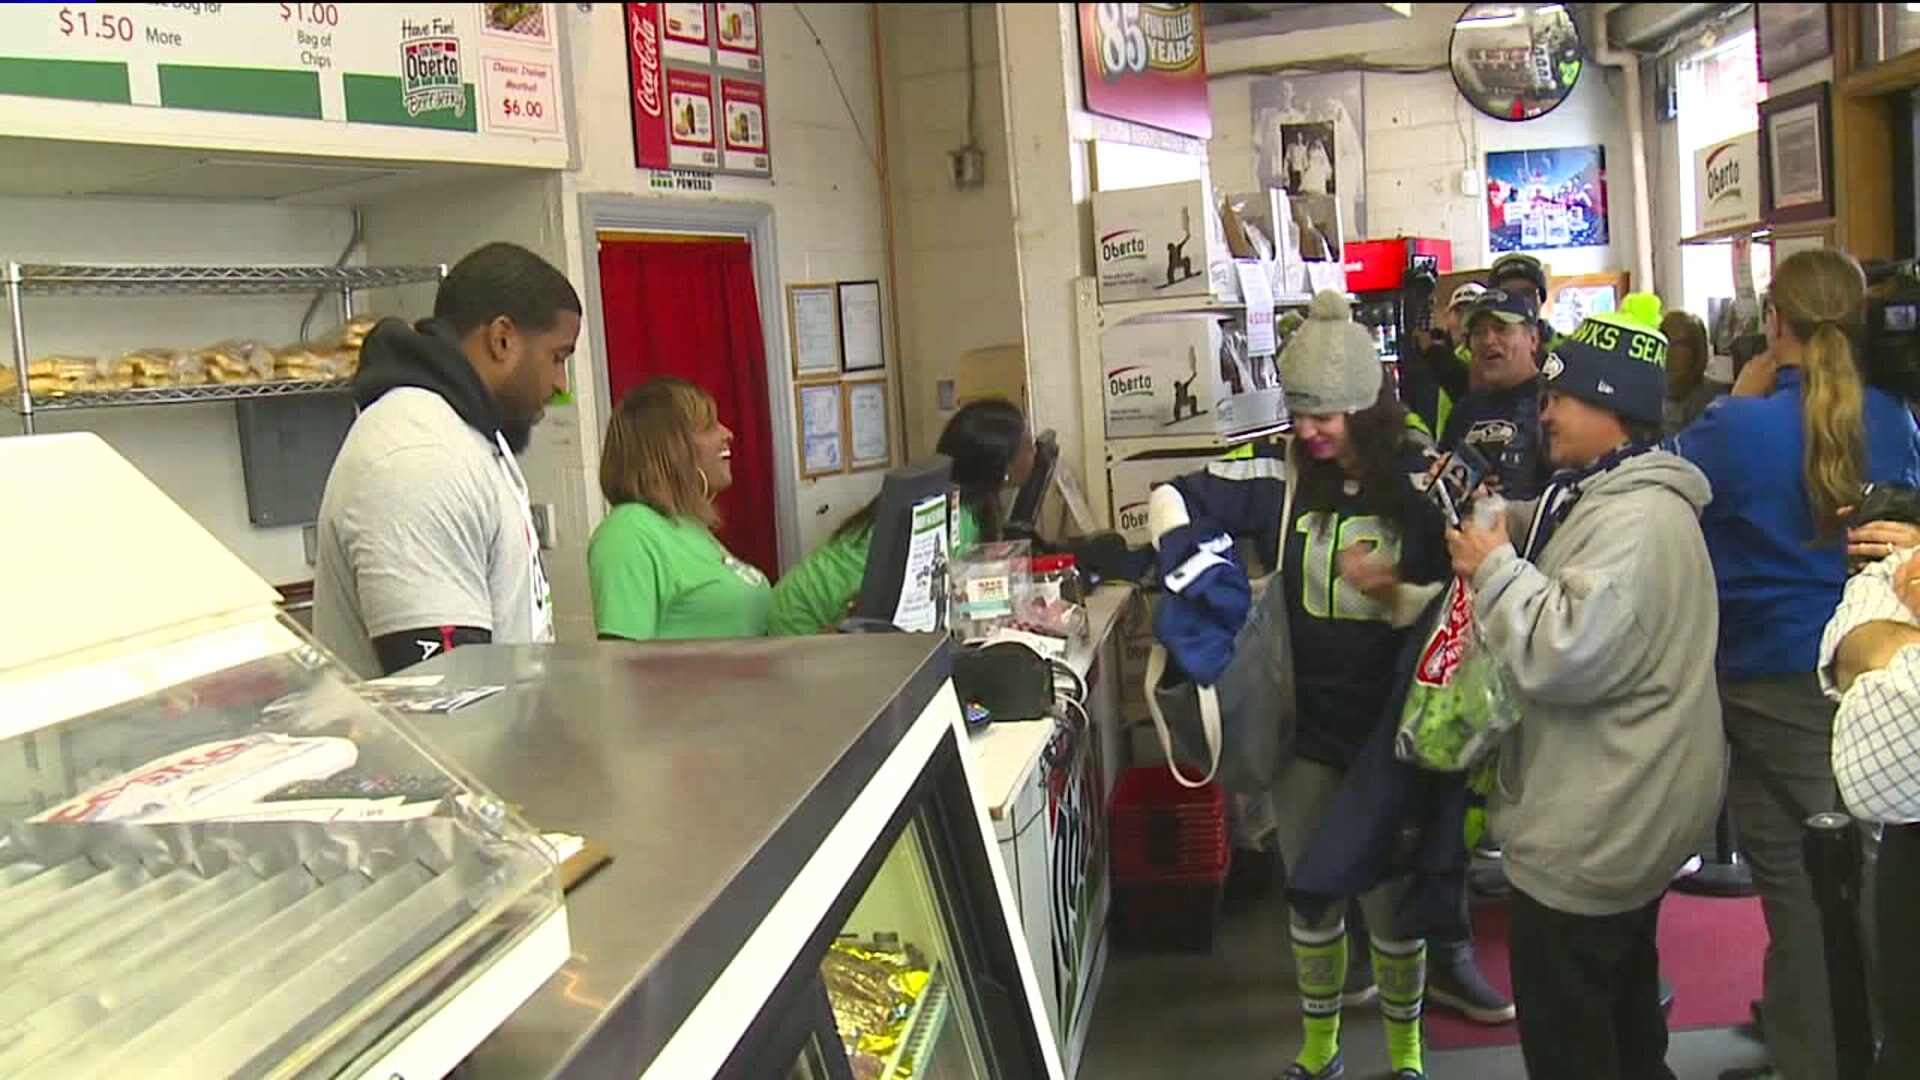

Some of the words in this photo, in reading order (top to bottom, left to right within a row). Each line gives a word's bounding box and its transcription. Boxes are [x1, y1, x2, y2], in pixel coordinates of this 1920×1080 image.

[59, 7, 134, 41] $1.50
[280, 3, 339, 26] $1.00
[145, 27, 182, 46] More
[297, 30, 319, 48] Bag
[321, 35, 332, 47] of
[402, 18, 429, 38] Have
[1098, 3, 1148, 73] 85
[301, 51, 332, 67] Chips
[1148, 35, 1194, 63] YEARS
[406, 54, 459, 81] Oberto
[632, 11, 661, 117] Coca-Cola
[503, 98, 543, 119] $6.00
[1707, 159, 1740, 200] Oberto
[1103, 237, 1145, 261] Oberto
[1110, 374, 1152, 396] Oberto
[1121, 512, 1149, 530] Ober
[1296, 511, 1404, 622] 12
